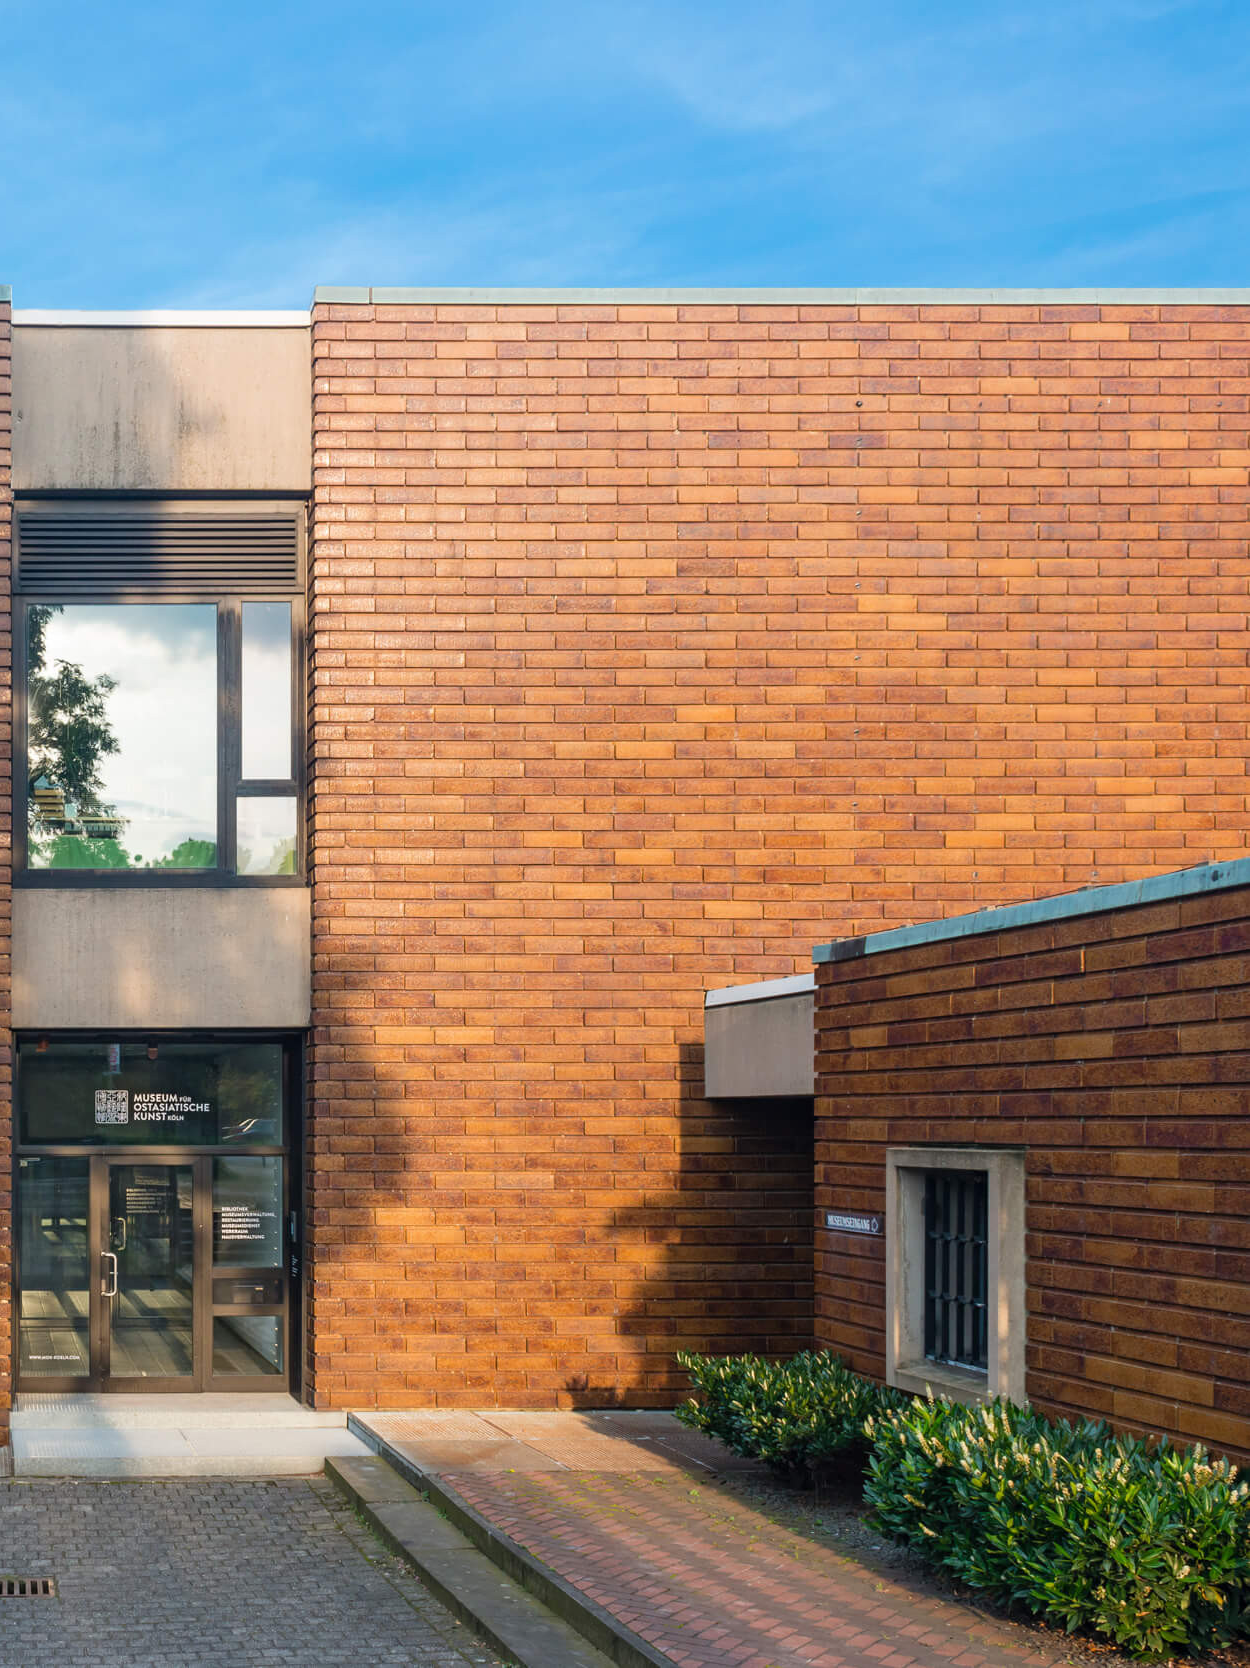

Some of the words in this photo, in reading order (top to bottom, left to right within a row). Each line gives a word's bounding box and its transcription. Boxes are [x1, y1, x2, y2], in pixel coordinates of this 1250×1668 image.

[133, 1093, 178, 1103] MUSEUM
[133, 1103, 210, 1112] OSTASIATISCHE
[133, 1112, 167, 1121] KUNST
